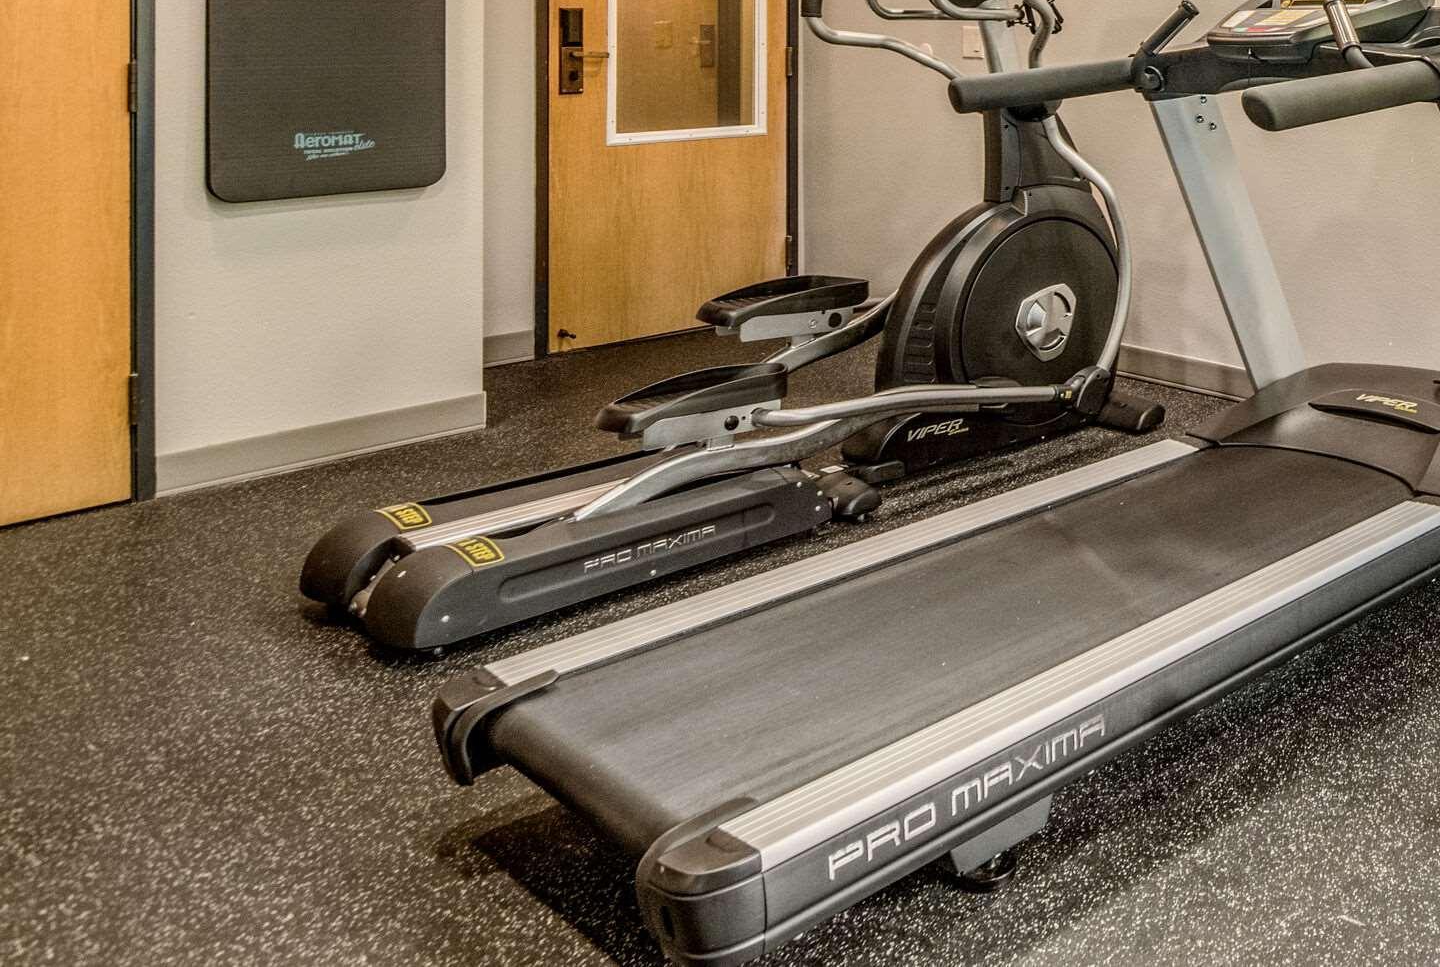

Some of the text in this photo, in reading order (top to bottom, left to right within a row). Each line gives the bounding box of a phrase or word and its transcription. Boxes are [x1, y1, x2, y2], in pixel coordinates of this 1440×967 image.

[1356, 394, 1418, 408] VIPER
[907, 418, 964, 443] VIPER
[583, 525, 717, 574] PRO MAXIMA
[827, 713, 1106, 881] PRO MAXIMA
